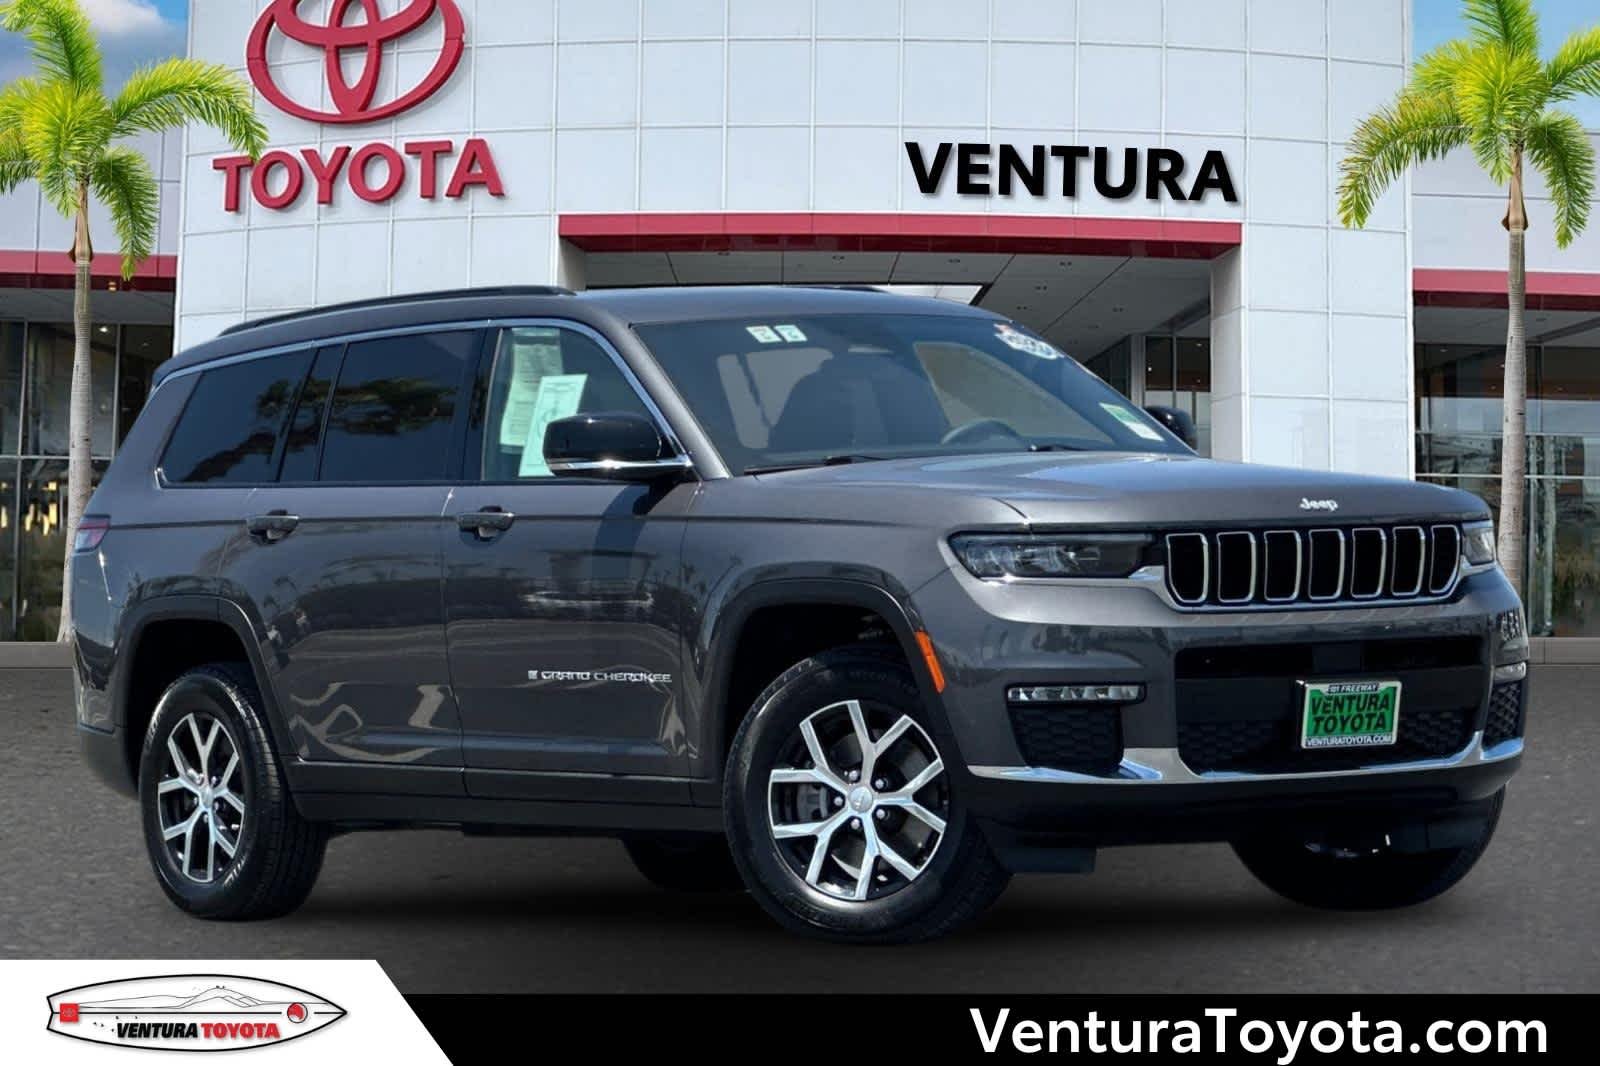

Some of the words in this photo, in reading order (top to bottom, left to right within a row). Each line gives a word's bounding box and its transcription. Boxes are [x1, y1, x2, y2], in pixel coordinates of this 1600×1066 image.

[212, 138, 505, 212] TOYOTA
[904, 141, 1238, 203] VENTURA
[1300, 498, 1338, 511] Jeep
[541, 670, 591, 681] GRAND
[594, 672, 672, 683] CHEROKEE
[1341, 684, 1376, 692] FREEWAY
[1311, 694, 1389, 714] VENTURA
[1313, 713, 1386, 734] TOYOTA
